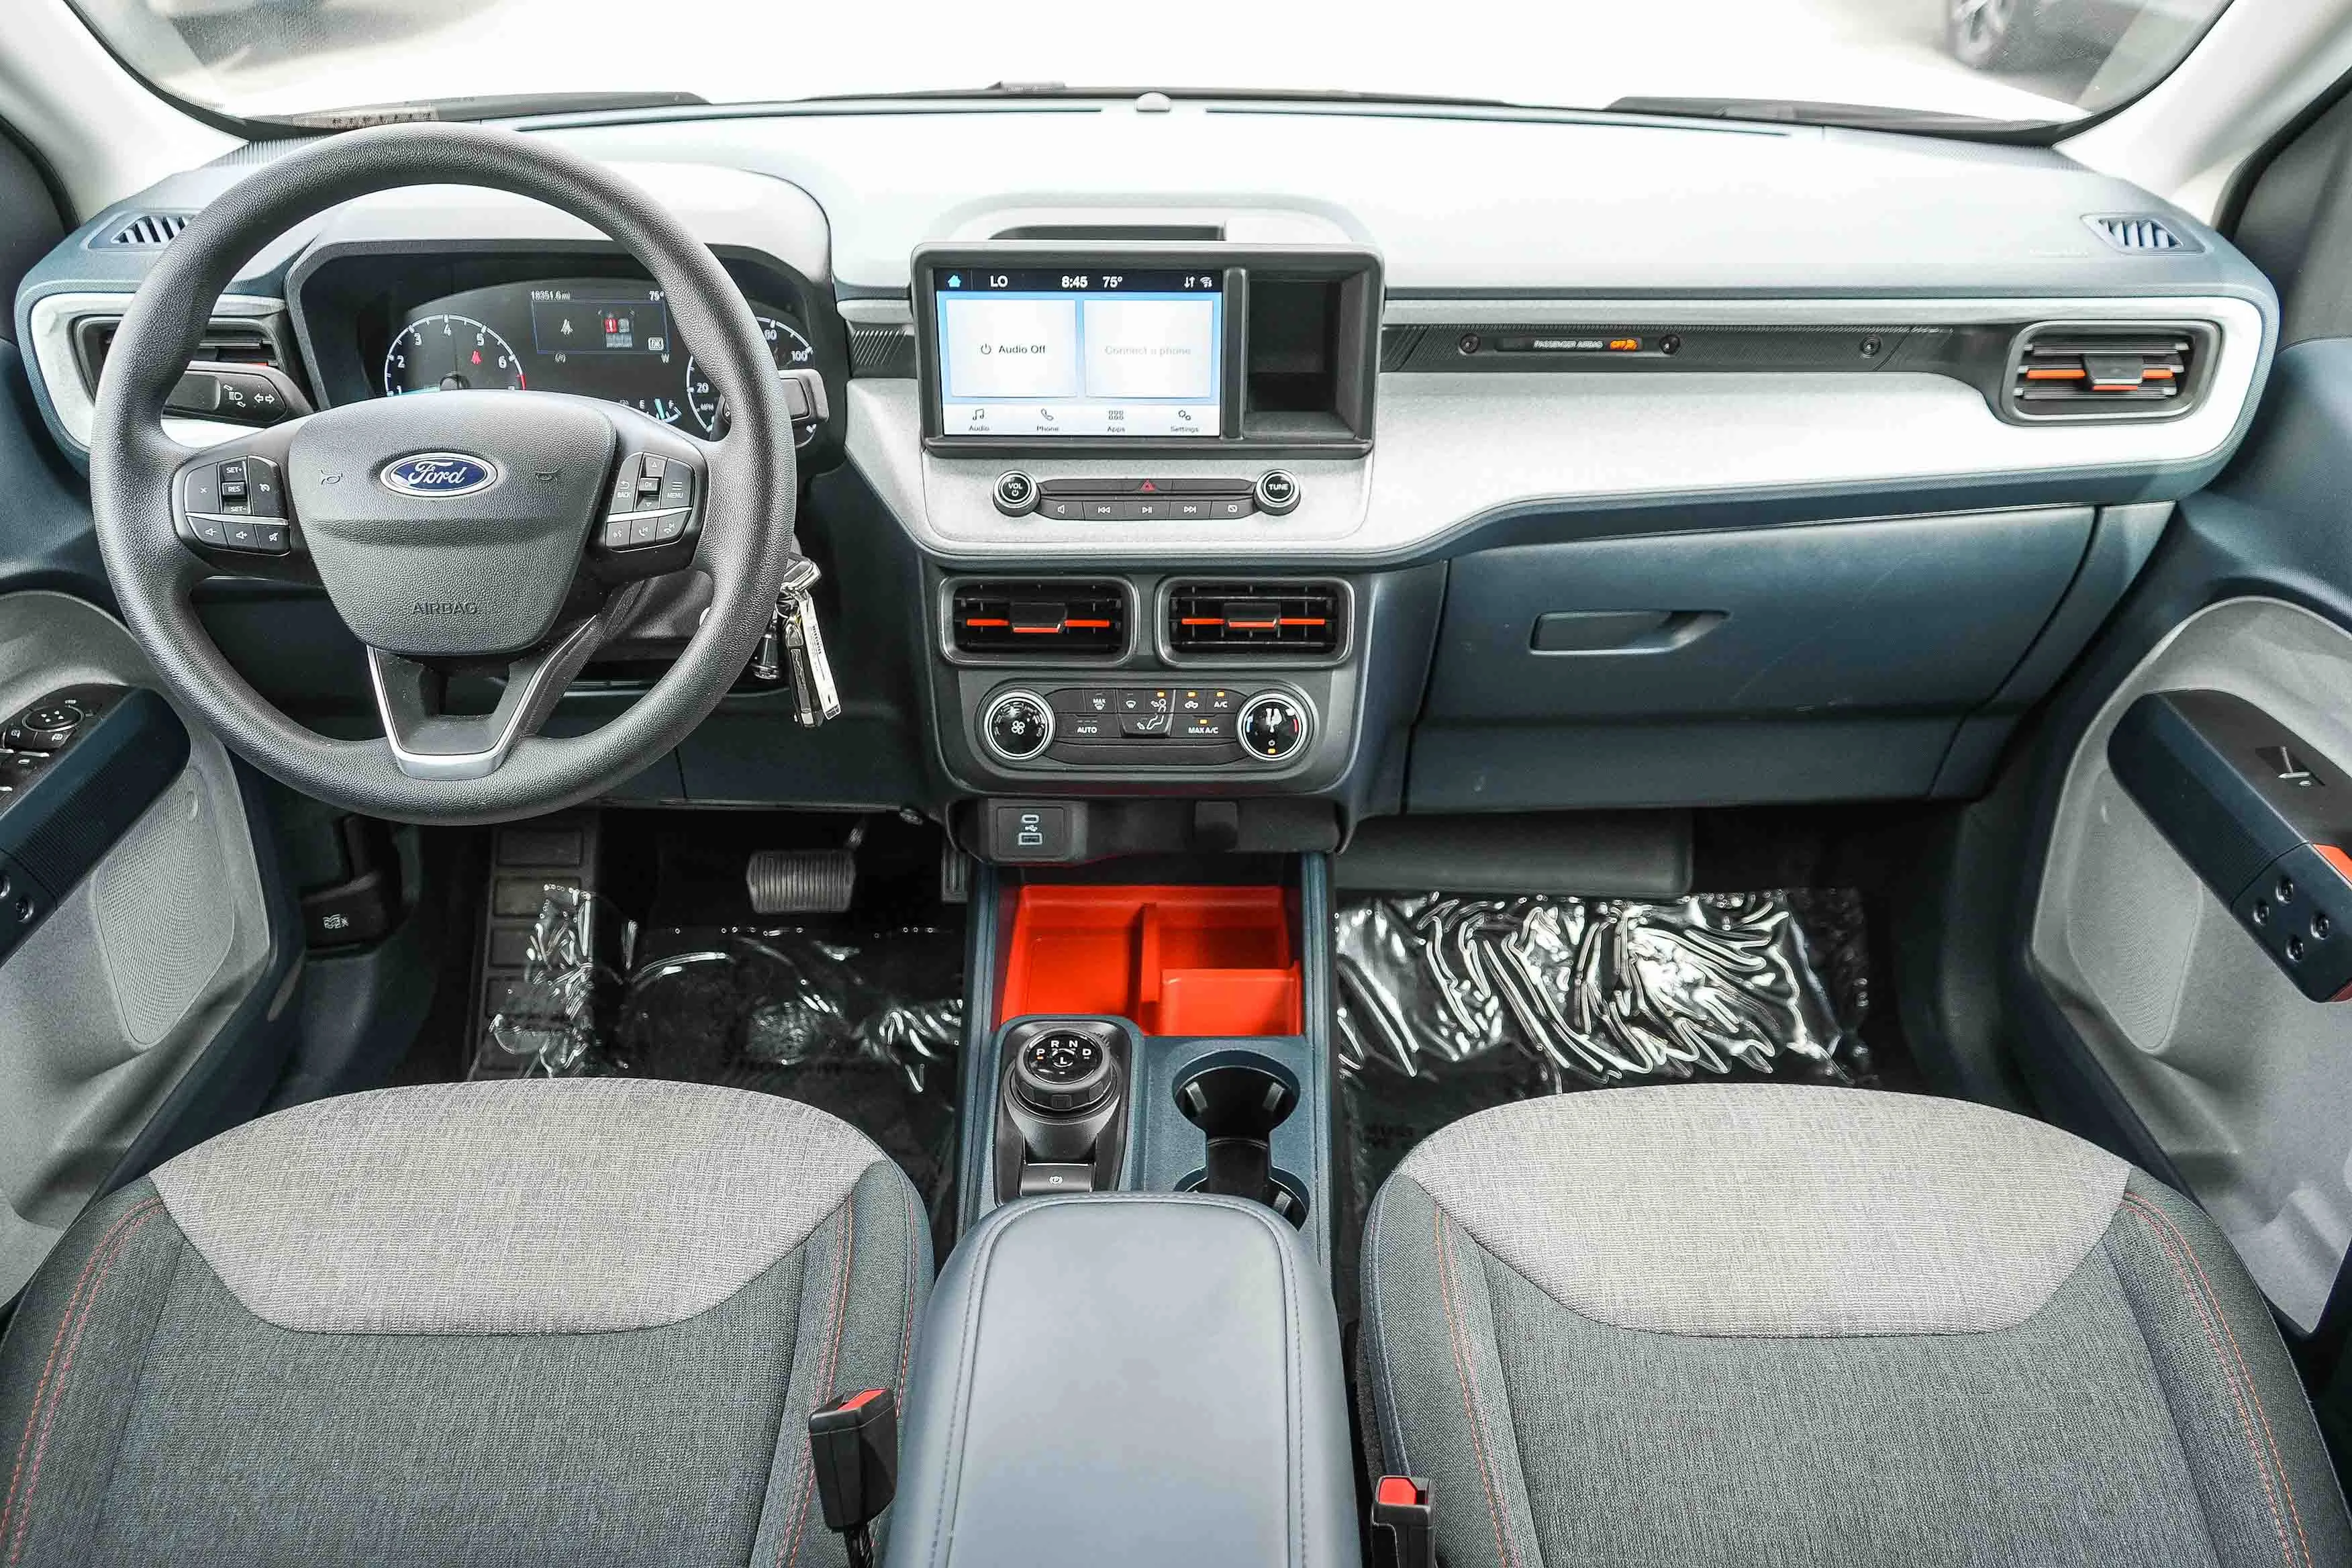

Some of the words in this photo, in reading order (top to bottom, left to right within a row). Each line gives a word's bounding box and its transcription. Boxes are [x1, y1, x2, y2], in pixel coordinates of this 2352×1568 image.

[990, 275, 1008, 287] LO
[1061, 276, 1088, 288] 8:45
[1102, 276, 1122, 288] 75°
[444, 324, 452, 336] 4
[413, 333, 422, 346] 3
[477, 334, 485, 346] 5
[998, 344, 1028, 354] Audio
[1030, 344, 1046, 354] Off
[1159, 346, 1191, 357] phone
[791, 350, 808, 361] 100
[397, 355, 405, 369] 2
[498, 356, 507, 369] 6
[697, 383, 709, 393] 20
[407, 461, 467, 485] Ford
[412, 602, 479, 615] AIRBAG
[1214, 700, 1228, 708] A/C
[1050, 1040, 1060, 1048] R
[1069, 1040, 1078, 1048] N
[1082, 1048, 1091, 1056] D
[1060, 1057, 1067, 1065] L
